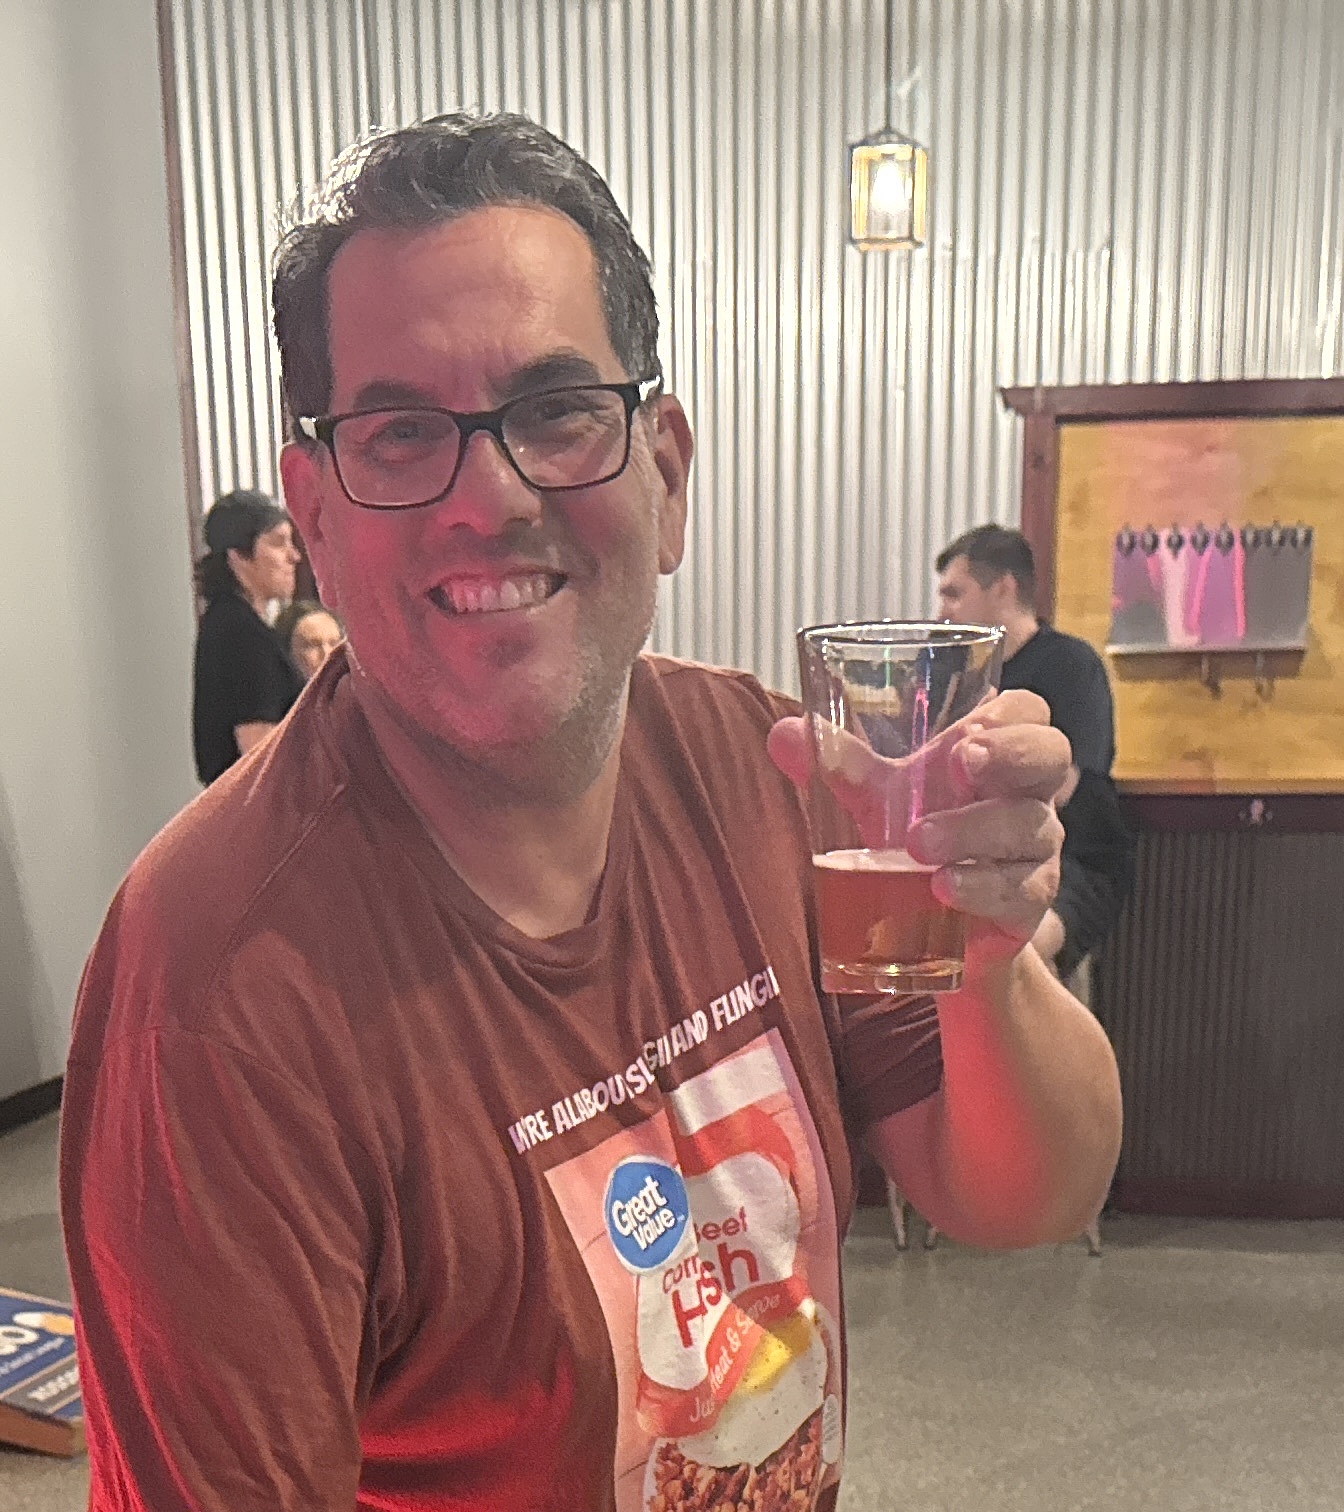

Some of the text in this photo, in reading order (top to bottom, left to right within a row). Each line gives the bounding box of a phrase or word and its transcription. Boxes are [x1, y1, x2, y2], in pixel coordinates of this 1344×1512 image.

[670, 1009, 709, 1058] AND
[612, 1175, 668, 1236] Great
[632, 1208, 676, 1250] Value
